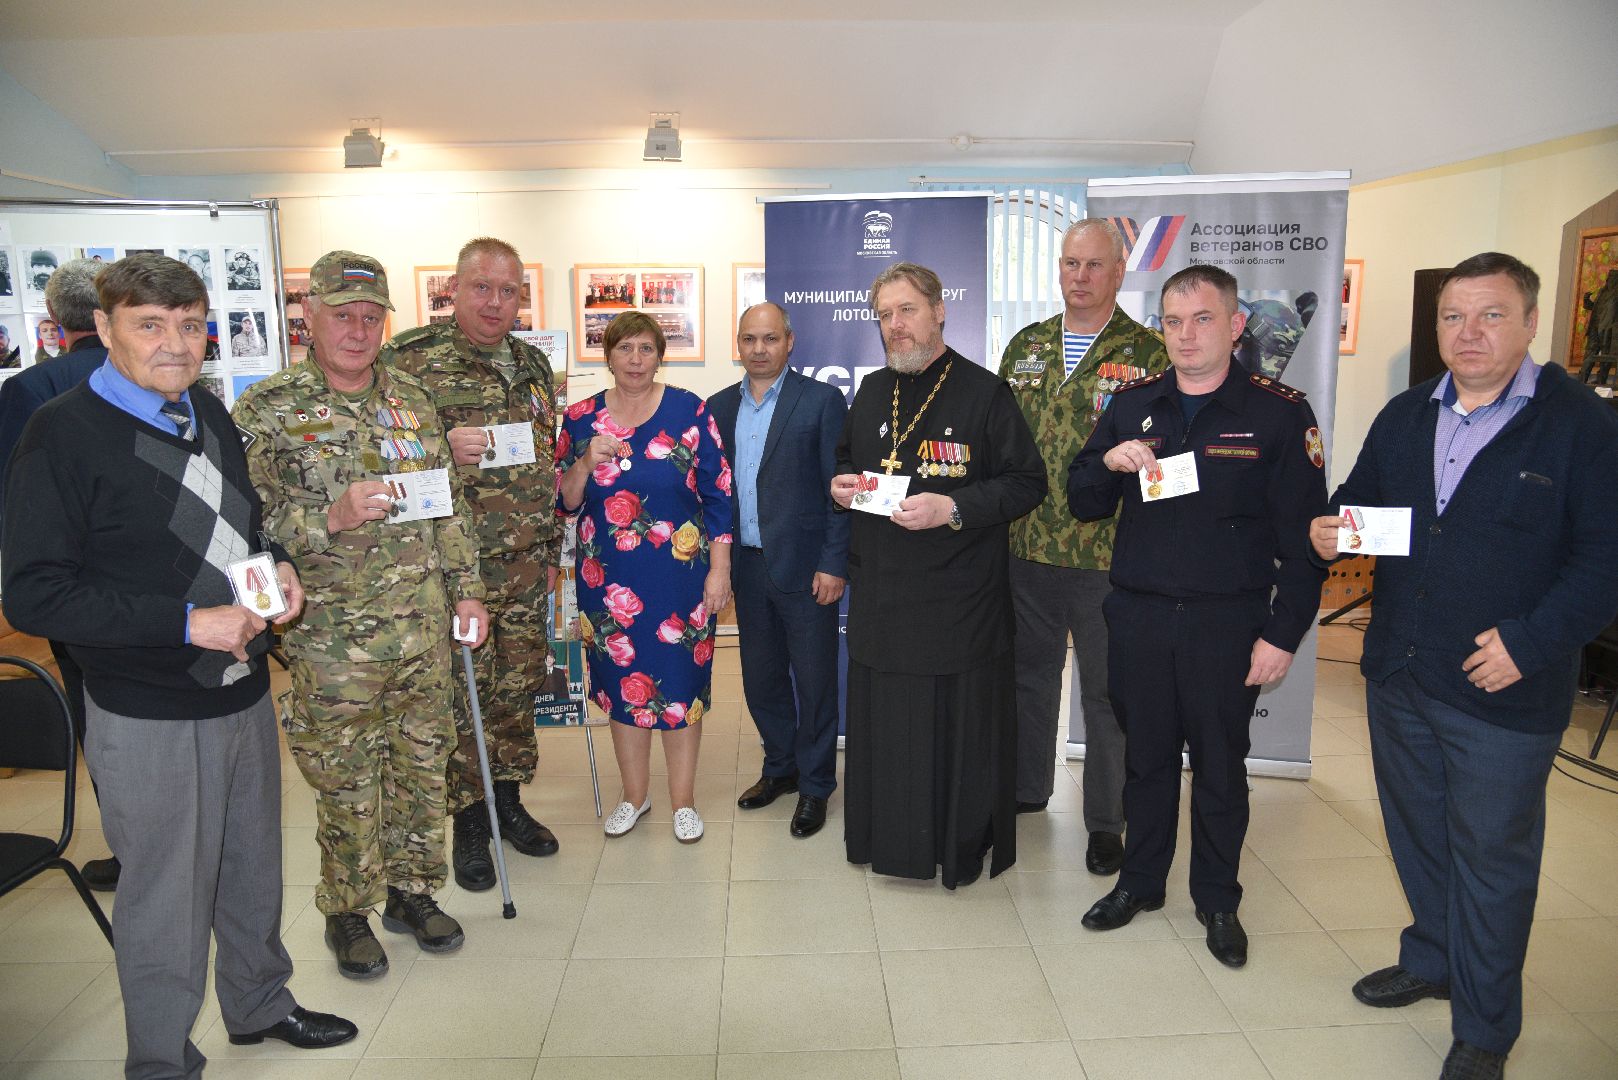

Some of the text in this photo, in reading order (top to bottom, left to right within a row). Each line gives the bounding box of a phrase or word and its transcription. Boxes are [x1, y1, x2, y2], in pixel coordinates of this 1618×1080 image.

[1190, 222, 1301, 237] Ассоциация
[1190, 236, 1329, 254] ветеранов СВО
[1247, 257, 1285, 265] области
[783, 288, 967, 304] МУНИЦИПАЛ РУГ
[832, 308, 881, 322] ЛОТОШ
[534, 692, 554, 704] ДНЕЙ
